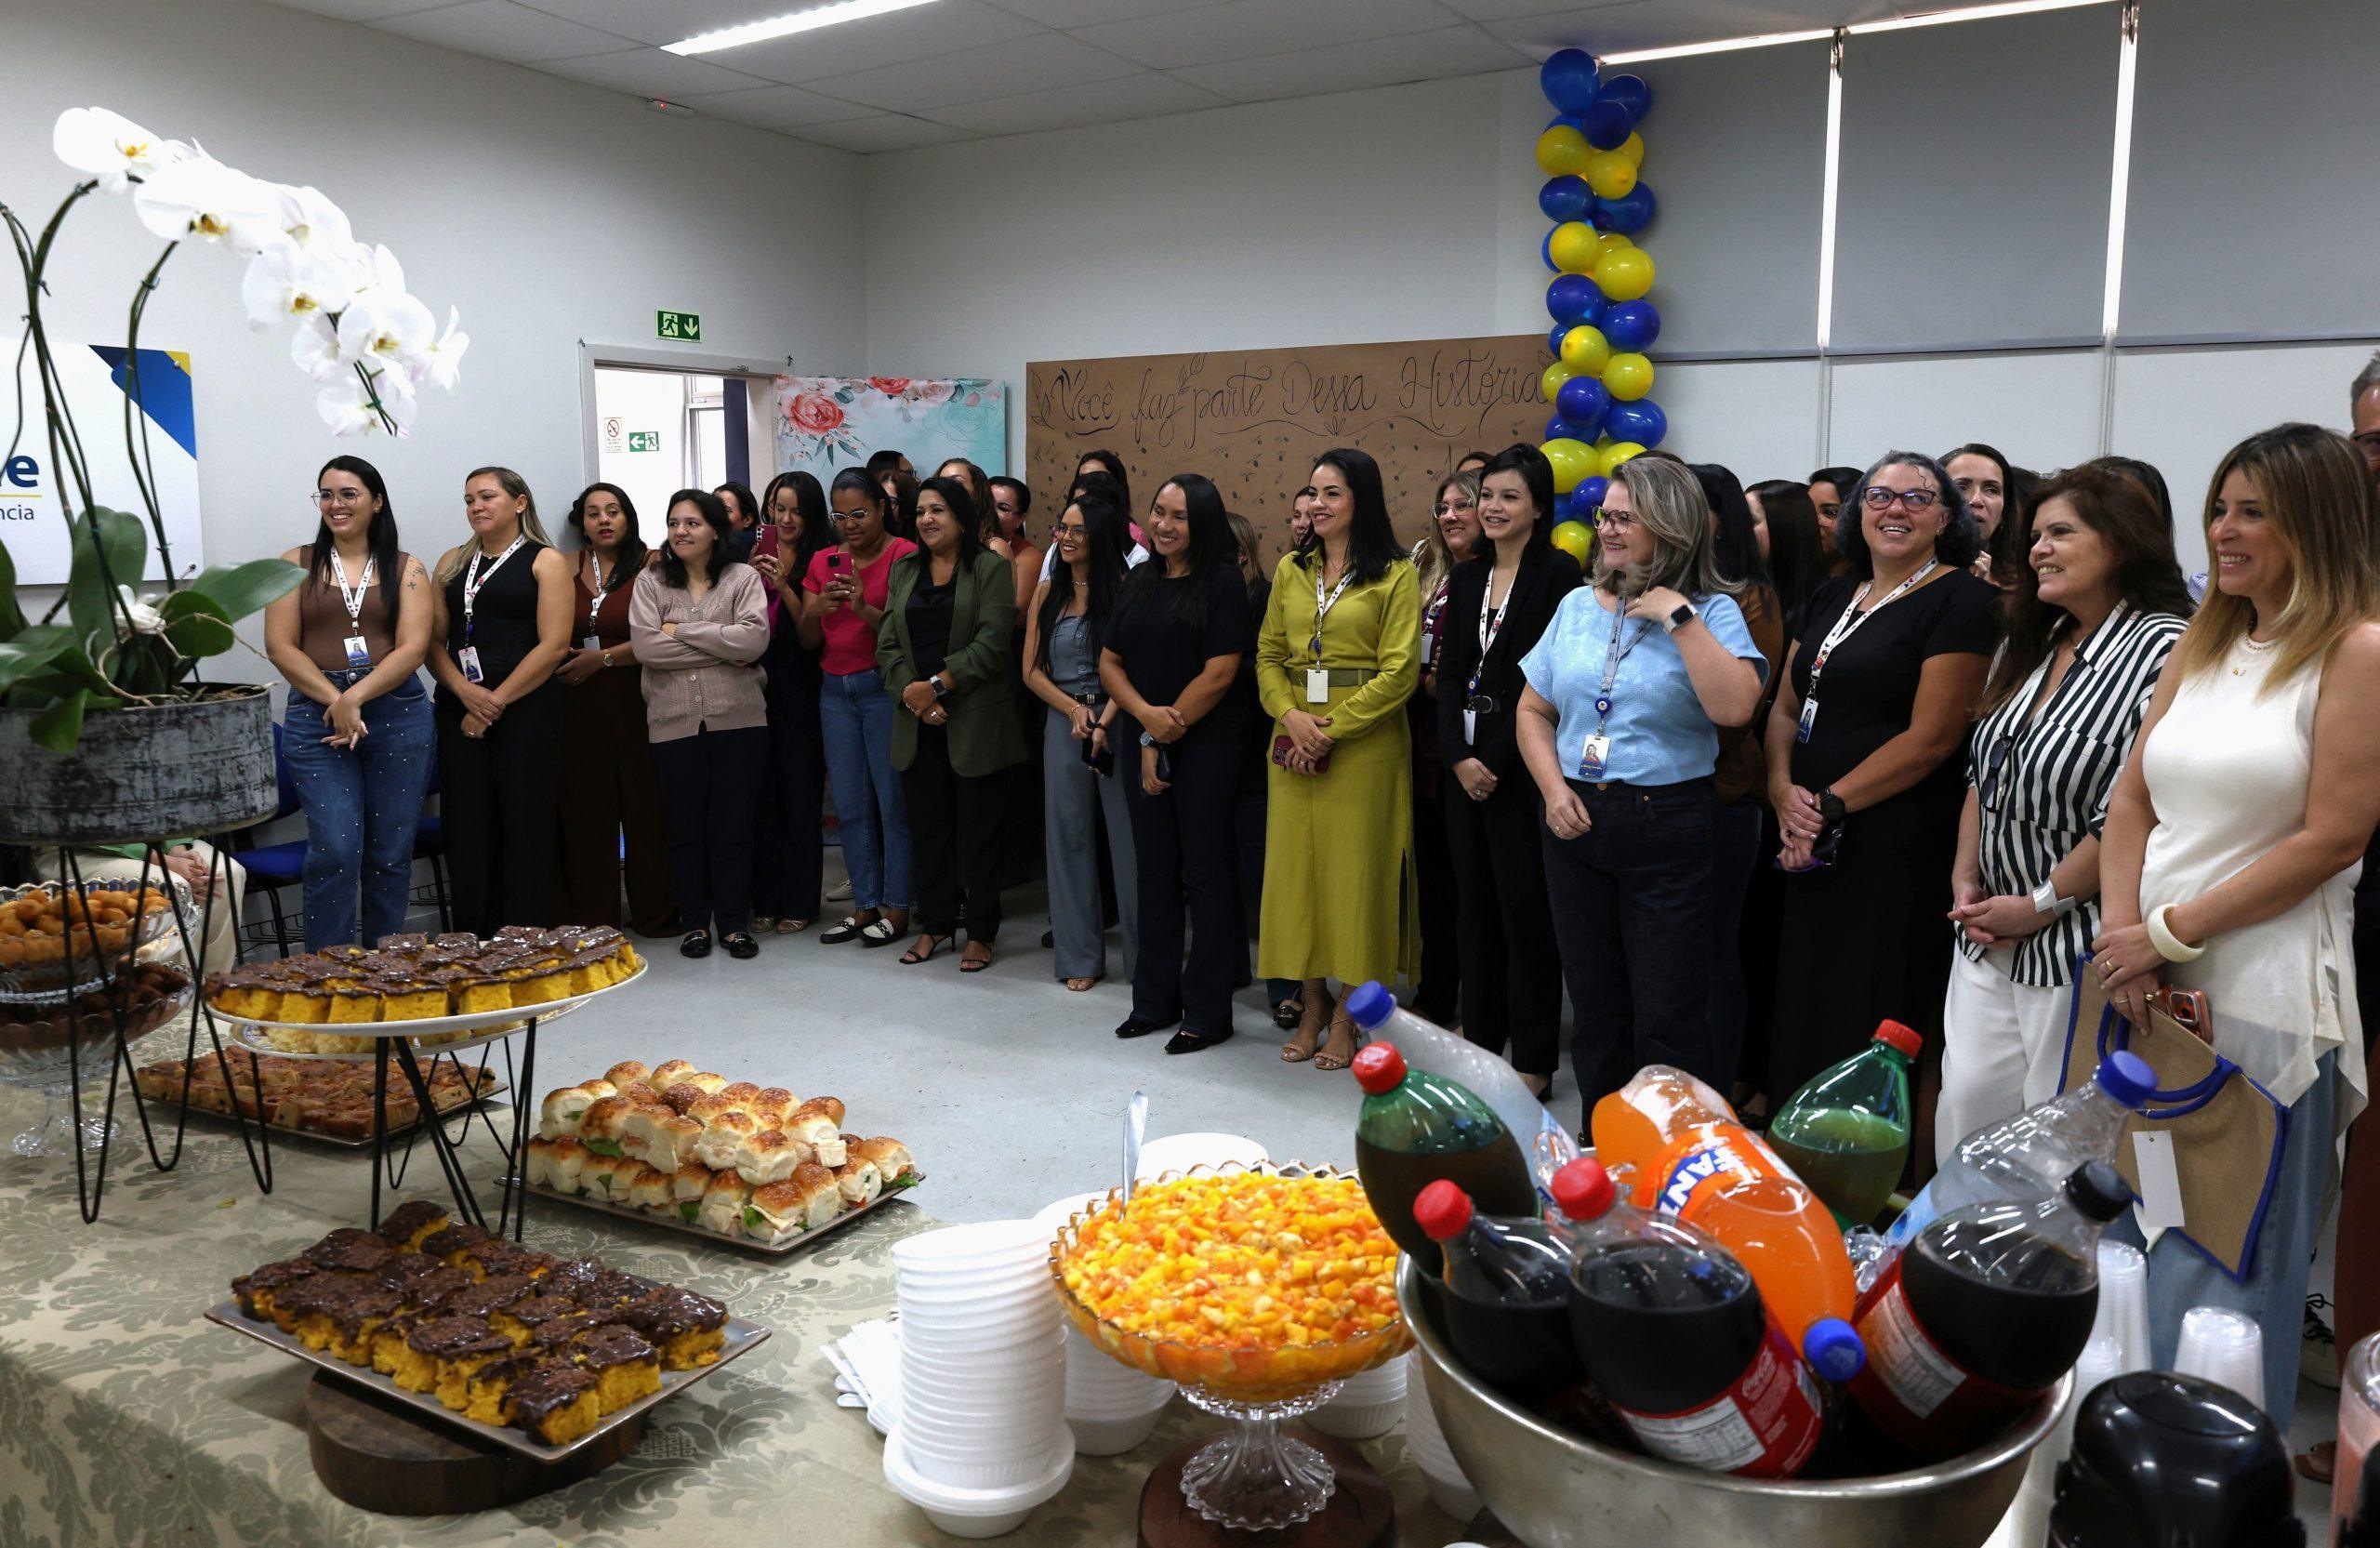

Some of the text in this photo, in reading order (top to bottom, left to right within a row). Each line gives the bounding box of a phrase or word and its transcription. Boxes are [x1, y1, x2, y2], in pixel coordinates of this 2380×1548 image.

[1051, 349, 1549, 449] Você faz parte Dessa História
